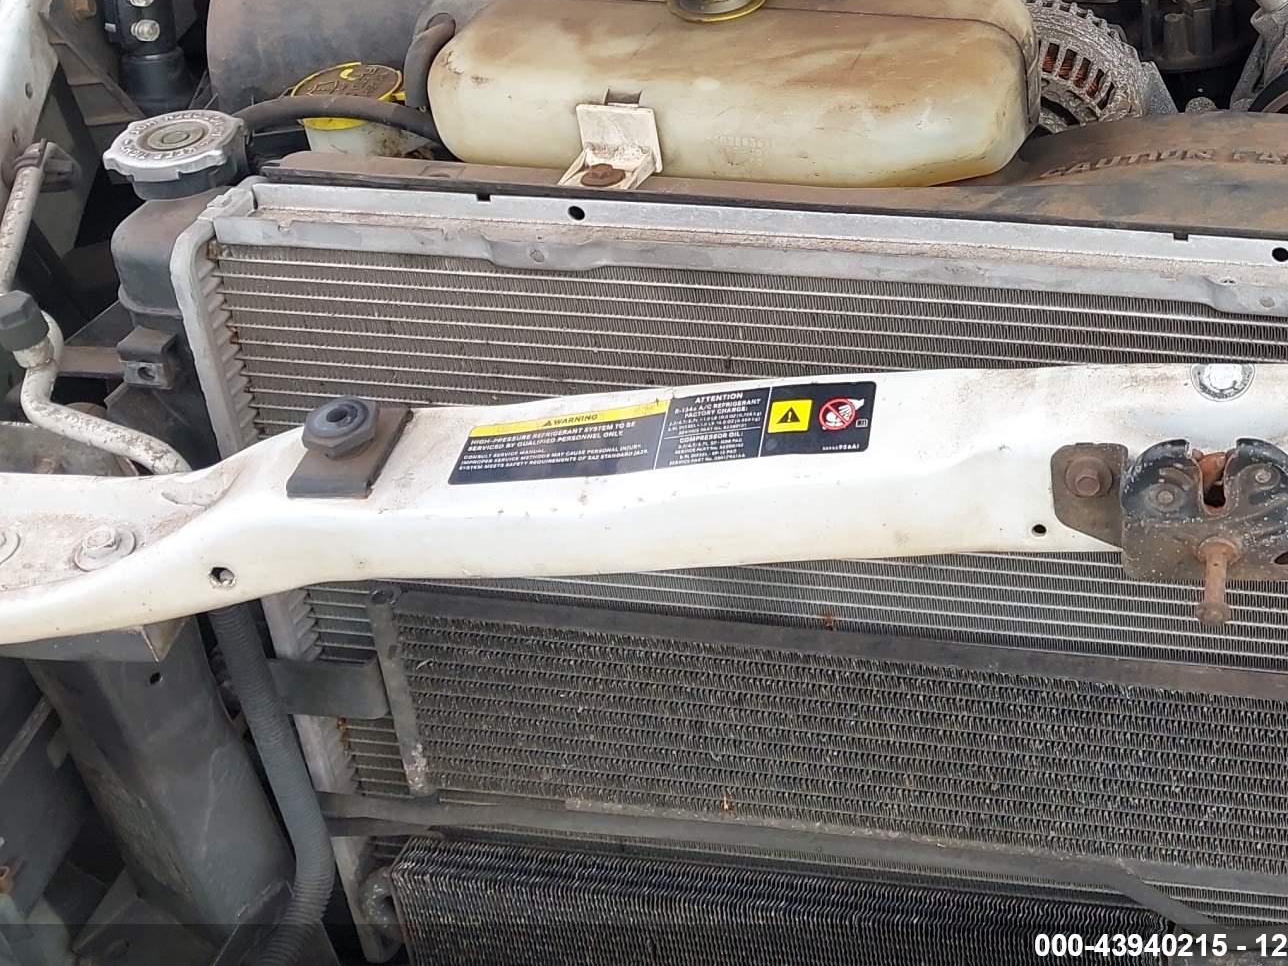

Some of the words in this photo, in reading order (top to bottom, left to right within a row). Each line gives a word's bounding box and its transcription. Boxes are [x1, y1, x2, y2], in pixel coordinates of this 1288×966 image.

[694, 392, 744, 404] ATTENTION
[712, 398, 761, 409] REFRIGERANT
[553, 414, 598, 424] WARNING
[684, 409, 716, 419] FACTORY
[470, 433, 531, 445] HIGH-PRESSURE
[583, 423, 614, 433] SYSTEM
[557, 433, 601, 443] PERSONNEL
[679, 432, 728, 444] COMPRESSOR
